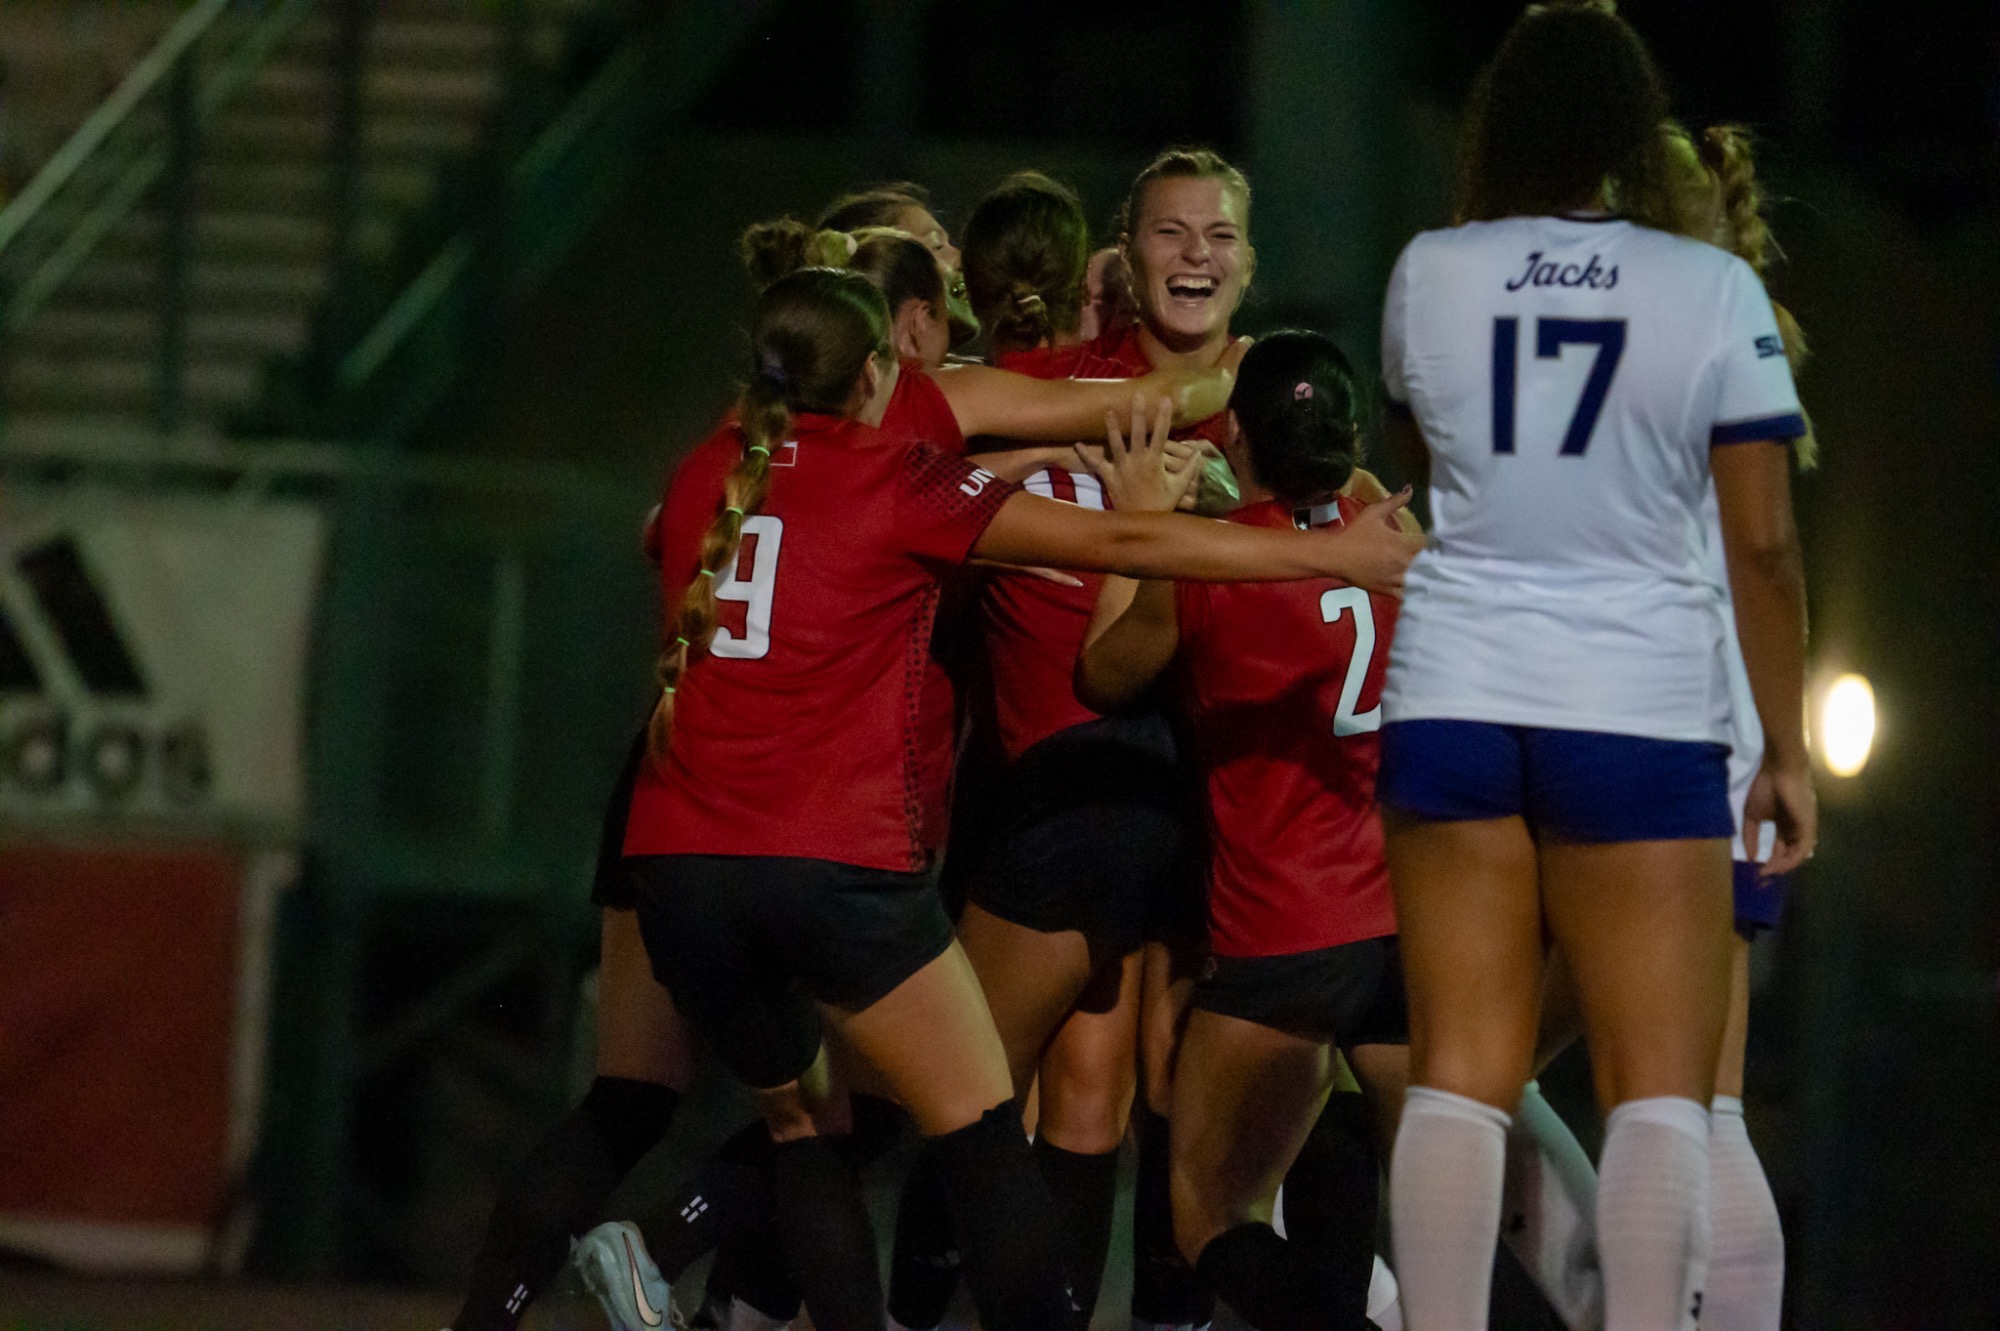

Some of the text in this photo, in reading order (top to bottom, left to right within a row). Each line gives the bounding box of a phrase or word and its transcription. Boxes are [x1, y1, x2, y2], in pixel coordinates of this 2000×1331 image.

[1506, 251, 1619, 291] Jacks
[1491, 316, 1628, 456] 17
[709, 514, 784, 660] 9
[1320, 586, 1382, 738] 2
